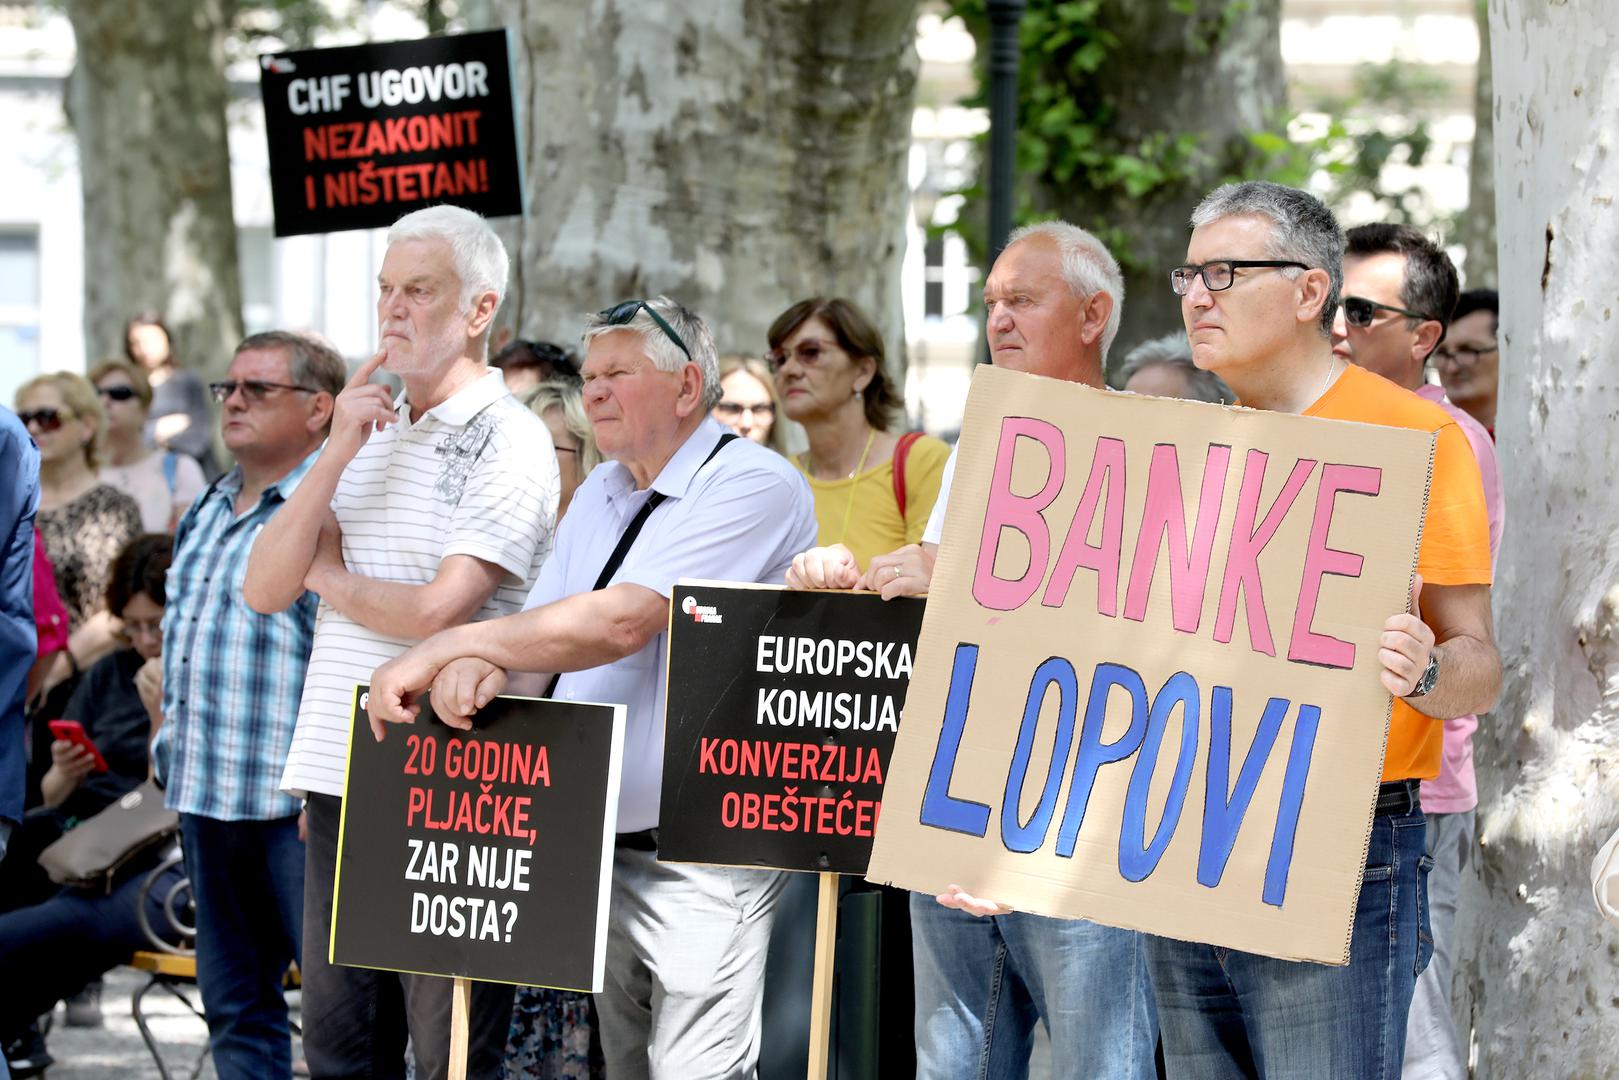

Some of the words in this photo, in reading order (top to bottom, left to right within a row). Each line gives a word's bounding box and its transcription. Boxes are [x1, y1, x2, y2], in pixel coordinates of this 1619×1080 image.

[288, 75, 350, 115] CHF
[357, 61, 488, 108] UGOVOR
[304, 111, 480, 161] NEZAKONIT
[305, 174, 317, 210] I
[324, 160, 489, 208] NIŠTETAN!
[971, 416, 1382, 670] BANKE
[756, 635, 913, 680] EUROPSKA
[404, 734, 437, 776] 20
[444, 737, 551, 787] GODINA
[699, 737, 883, 785] KONVERZIJA
[919, 642, 1321, 909] LOPOVI
[406, 782, 537, 846] PLJAČKE,
[721, 785, 881, 837] OBEŠTEĆE
[404, 838, 460, 885] ZAR
[466, 844, 533, 892] NIJE
[410, 892, 519, 943] DOSTA?
